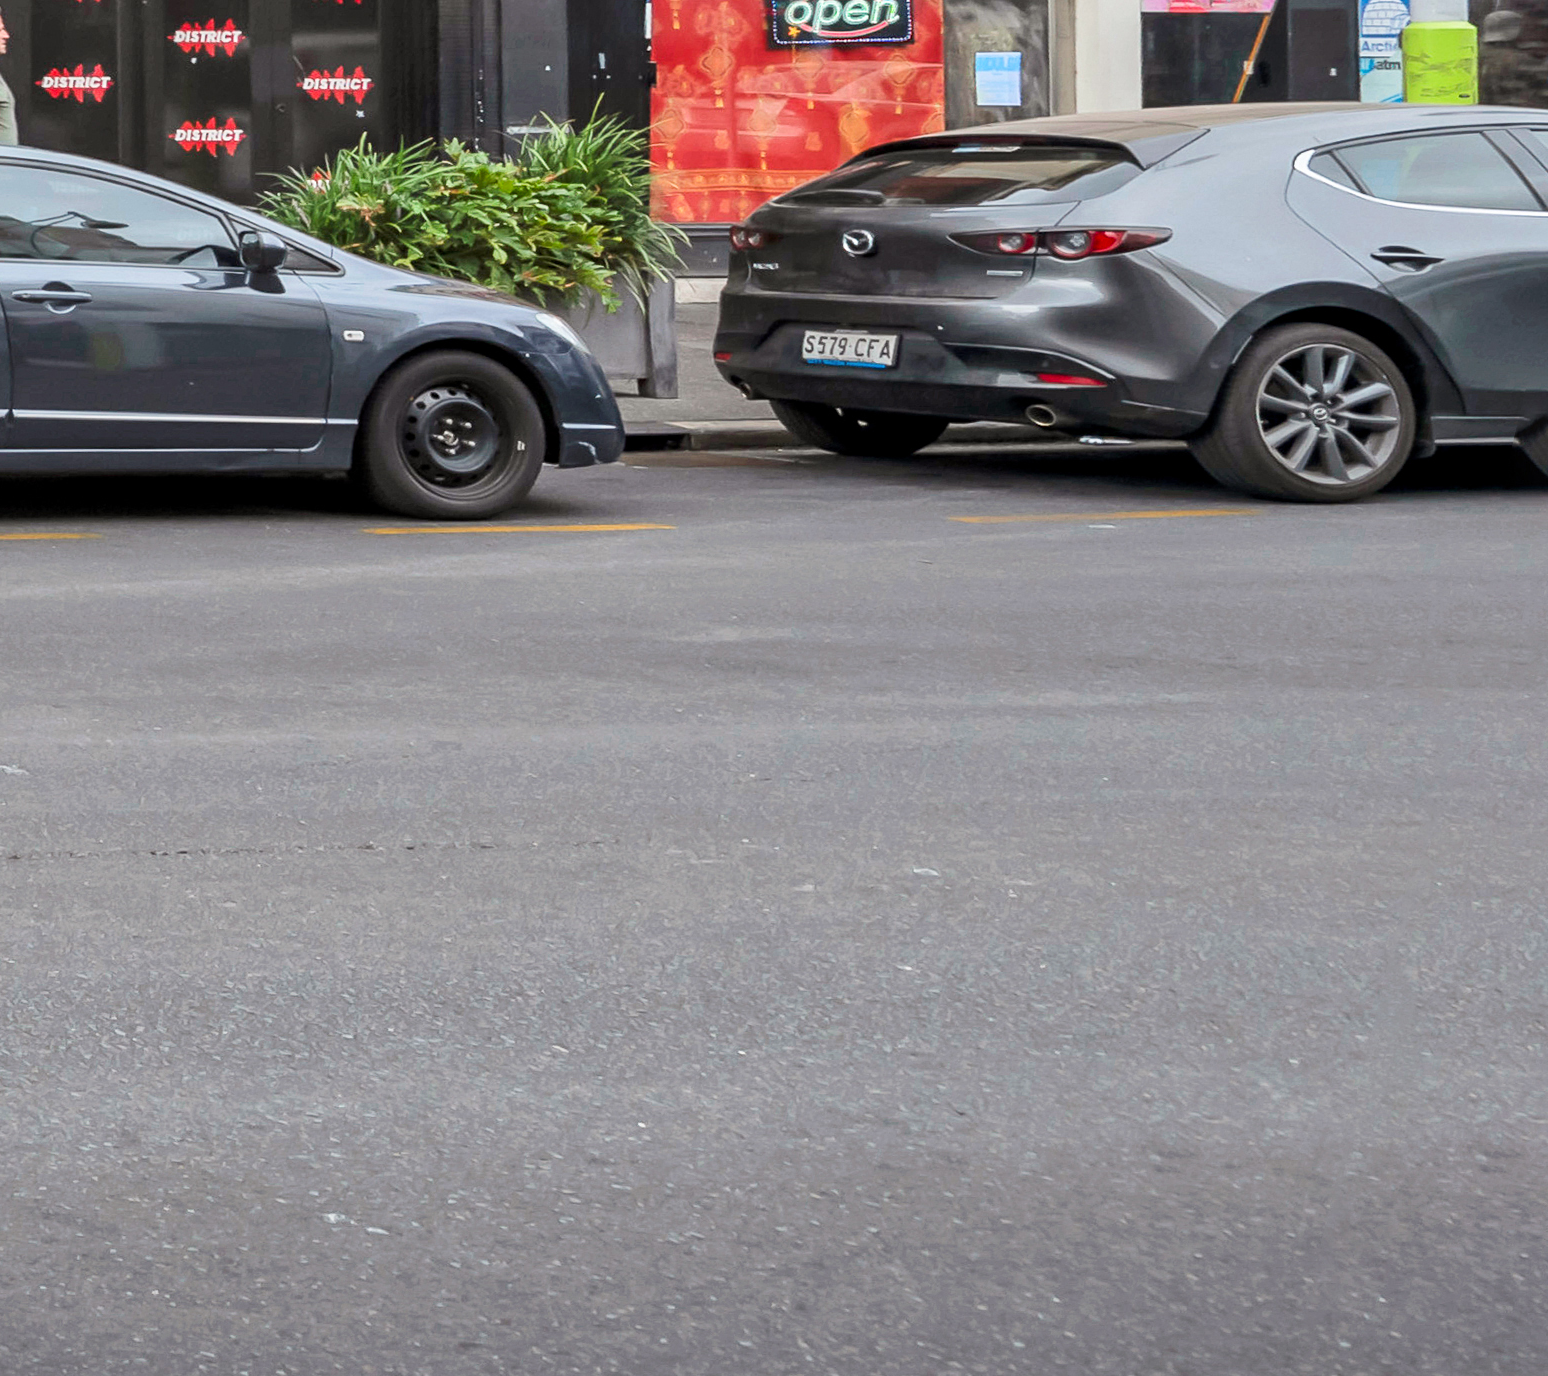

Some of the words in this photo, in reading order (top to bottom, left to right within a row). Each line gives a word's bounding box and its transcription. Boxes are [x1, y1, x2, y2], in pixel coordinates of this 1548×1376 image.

[173, 30, 243, 44] DISTRICT
[41, 75, 111, 89] DISTRICT
[302, 77, 372, 91] DISTRICT
[174, 128, 244, 142] DISTRICT
